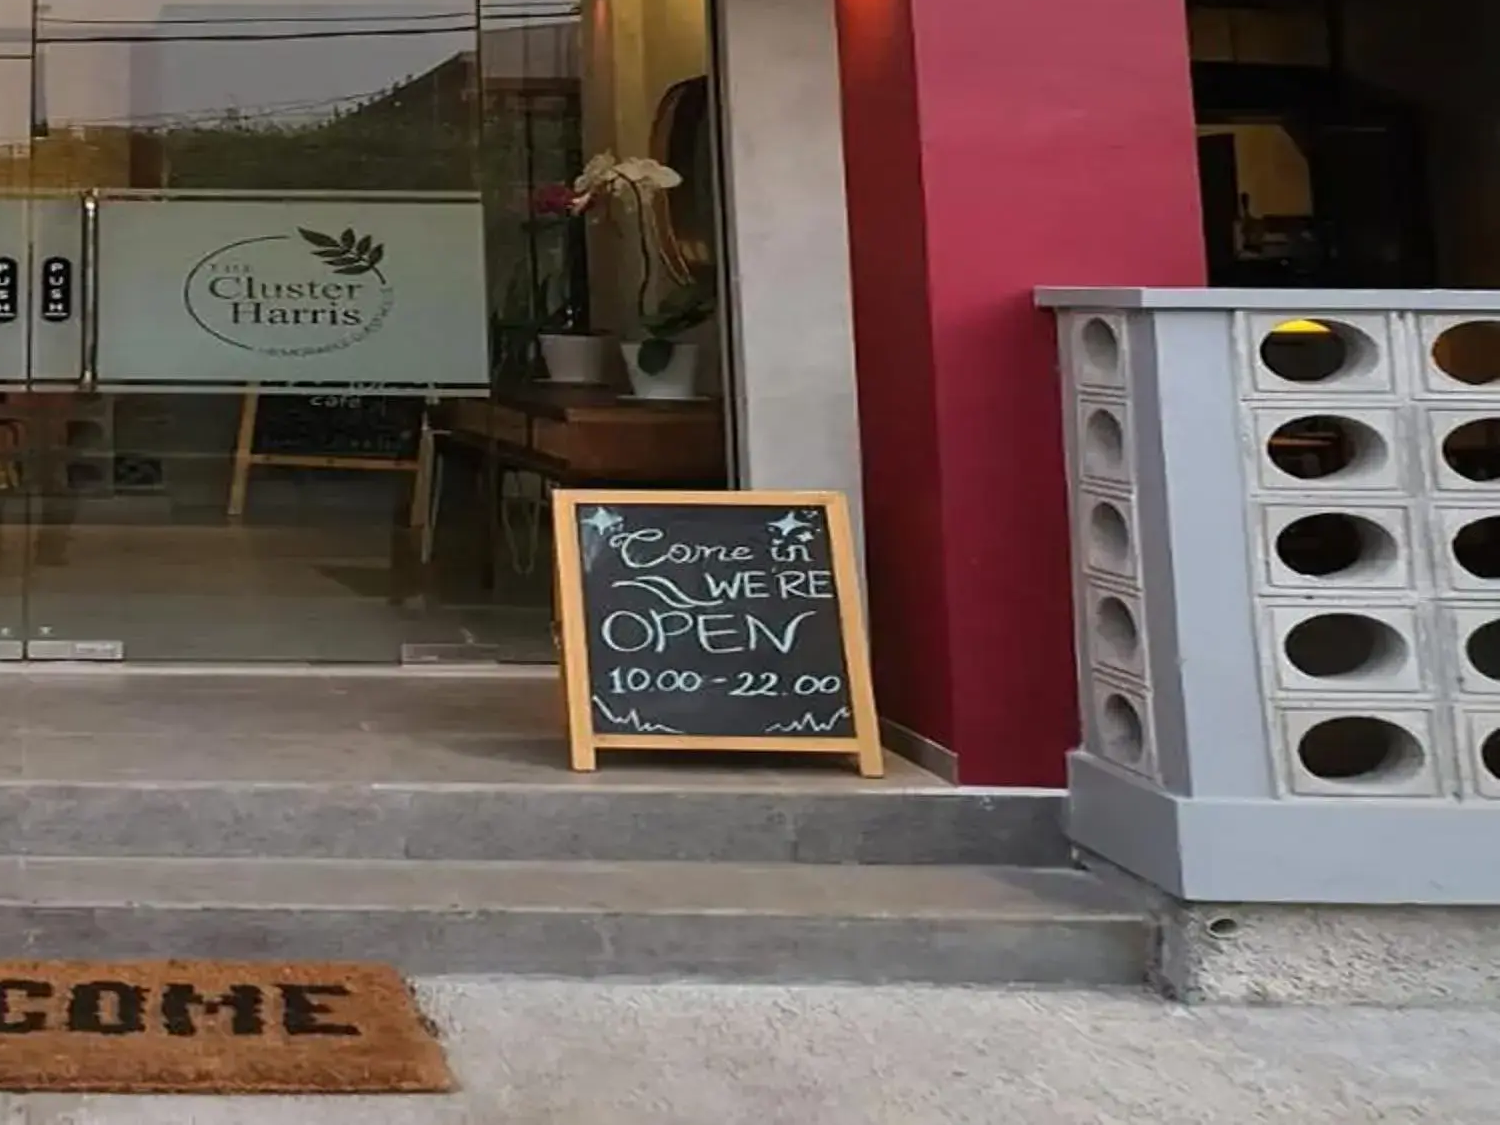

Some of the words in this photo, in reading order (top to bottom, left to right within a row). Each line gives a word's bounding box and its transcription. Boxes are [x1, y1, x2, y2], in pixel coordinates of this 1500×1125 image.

[49, 262, 64, 311] PUSH
[208, 277, 363, 300] Cluster
[232, 302, 361, 325] Harris
[609, 528, 754, 568] Come
[771, 539, 813, 562] in
[602, 609, 816, 654] OPEN
